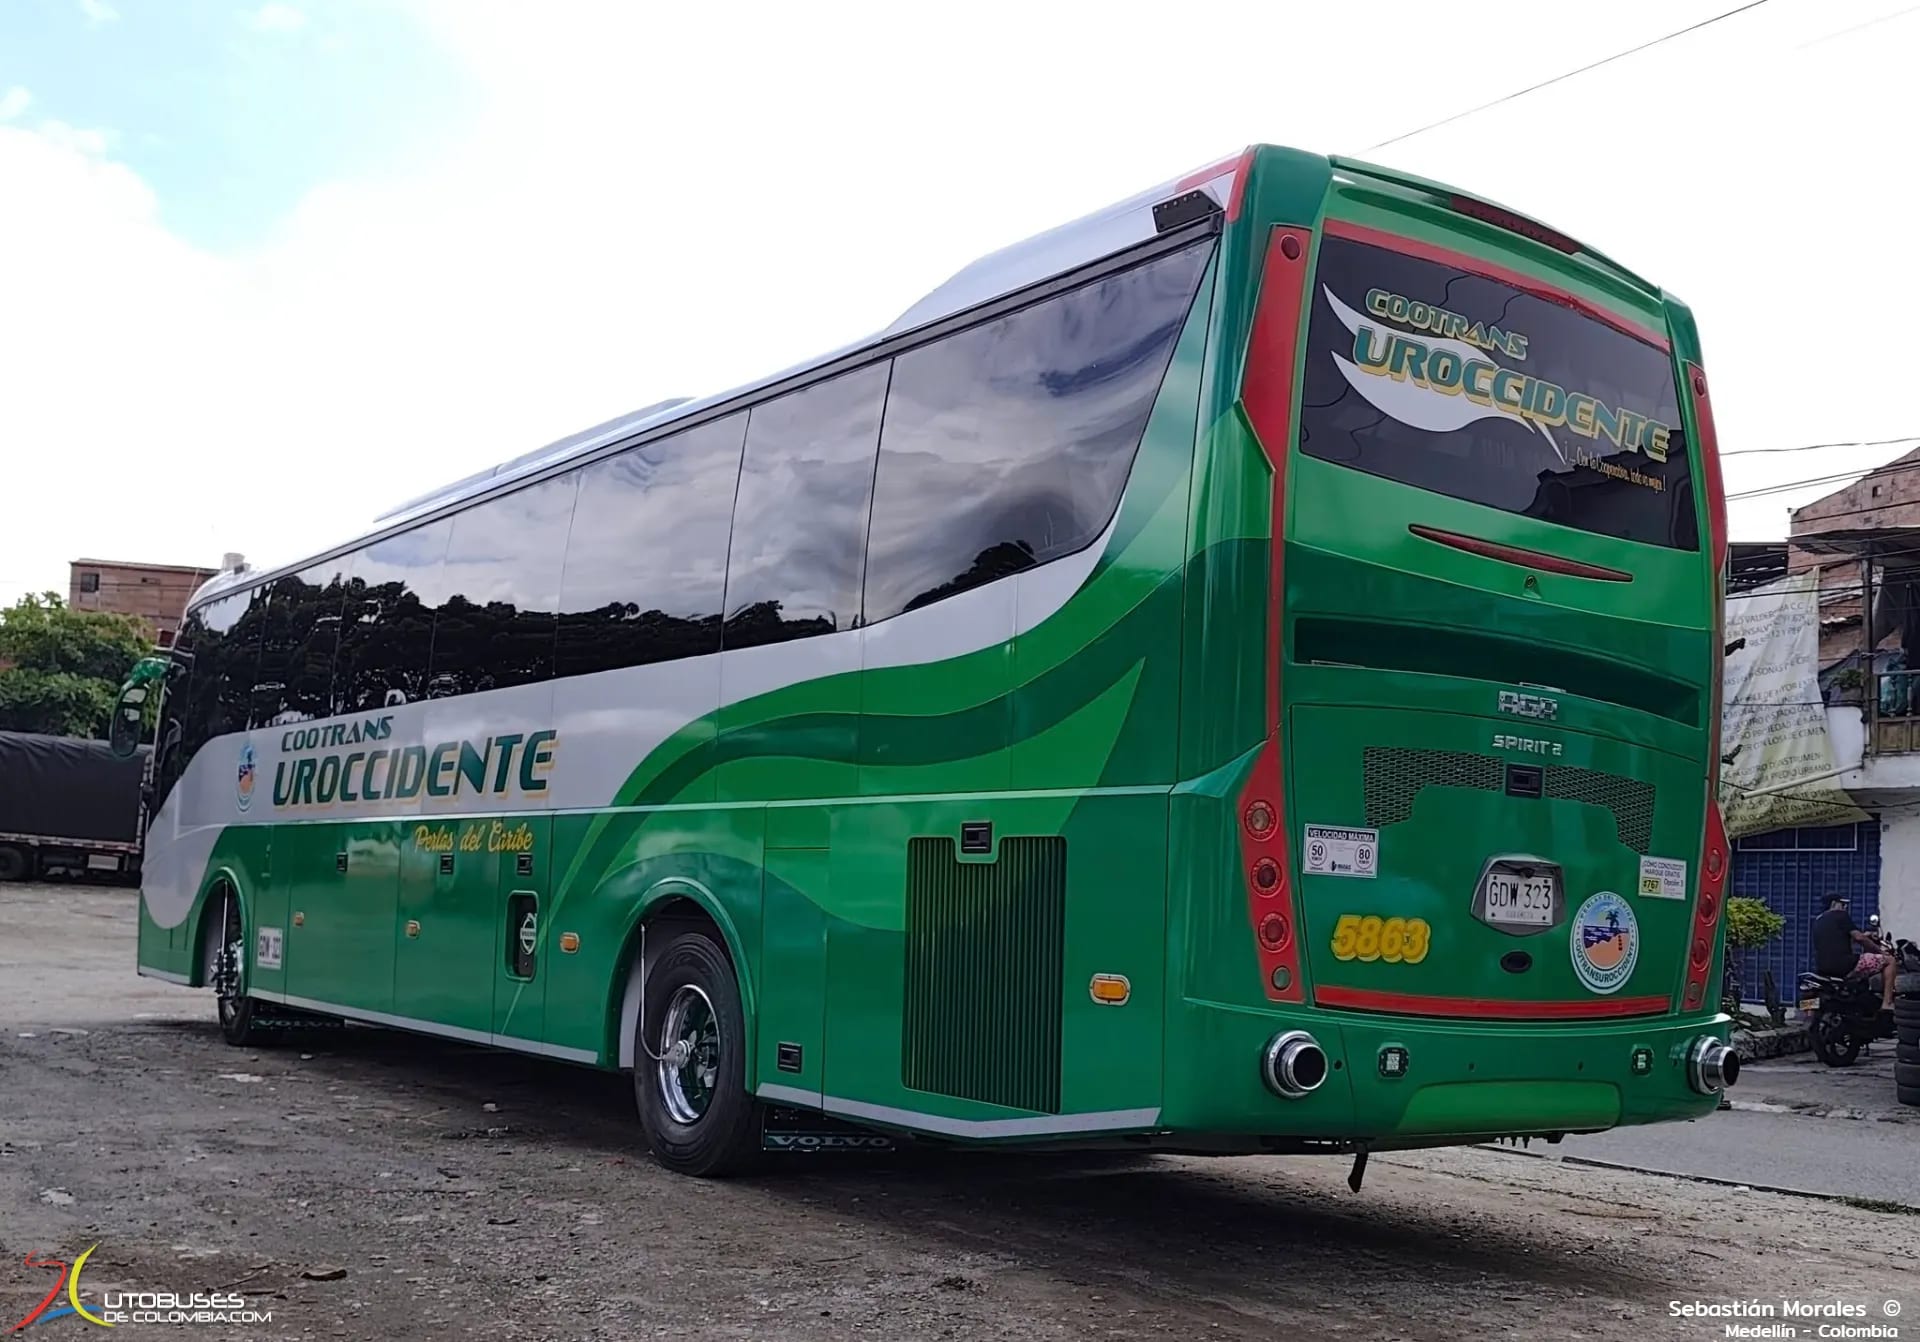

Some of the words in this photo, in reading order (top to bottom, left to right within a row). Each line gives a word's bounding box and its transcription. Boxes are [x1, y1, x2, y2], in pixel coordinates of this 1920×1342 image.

[1366, 288, 1528, 360] COOTRANS
[1352, 325, 1670, 462] UROCCIDENTE
[282, 715, 394, 752] COOTRANS
[1492, 734, 1550, 755] SPIRIT
[1552, 743, 1562, 756] 2
[273, 729, 557, 808] UROCCIDENTE
[415, 825, 454, 853] Perlas
[460, 824, 486, 852] del
[488, 820, 533, 852] Caribe
[1309, 829, 1347, 840] VELOCIDAD
[1312, 845, 1323, 856] 50
[1359, 848, 1370, 860] 80
[1489, 882, 1519, 907] GDW
[1524, 883, 1551, 910] 323
[1331, 915, 1431, 963] 5863
[1575, 938, 1635, 984] COOTRANSUROCCIDENTE
[768, 1134, 891, 1148] VOLVO
